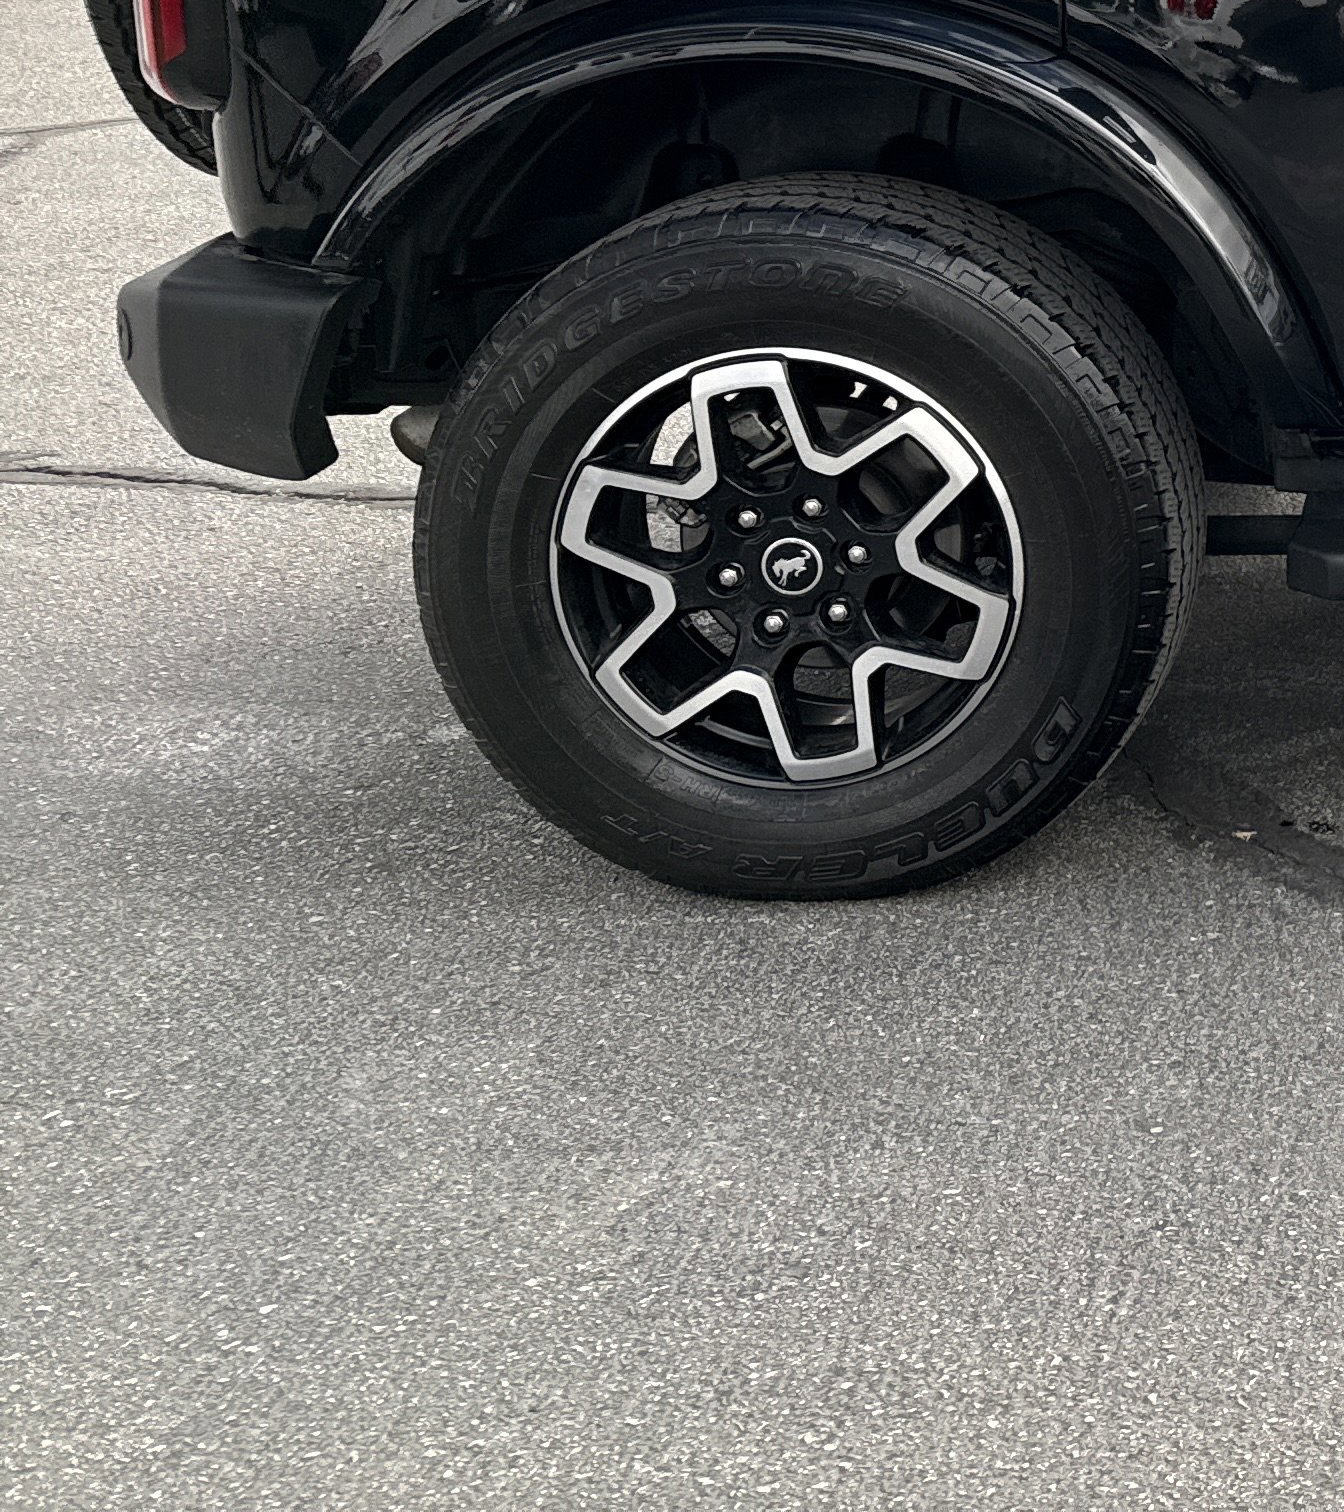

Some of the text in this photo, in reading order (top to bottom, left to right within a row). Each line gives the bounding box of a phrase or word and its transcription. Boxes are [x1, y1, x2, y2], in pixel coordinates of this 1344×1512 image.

[453, 257, 909, 510] BRIDGESTONE
[601, 696, 1082, 881] DUELER A/T
